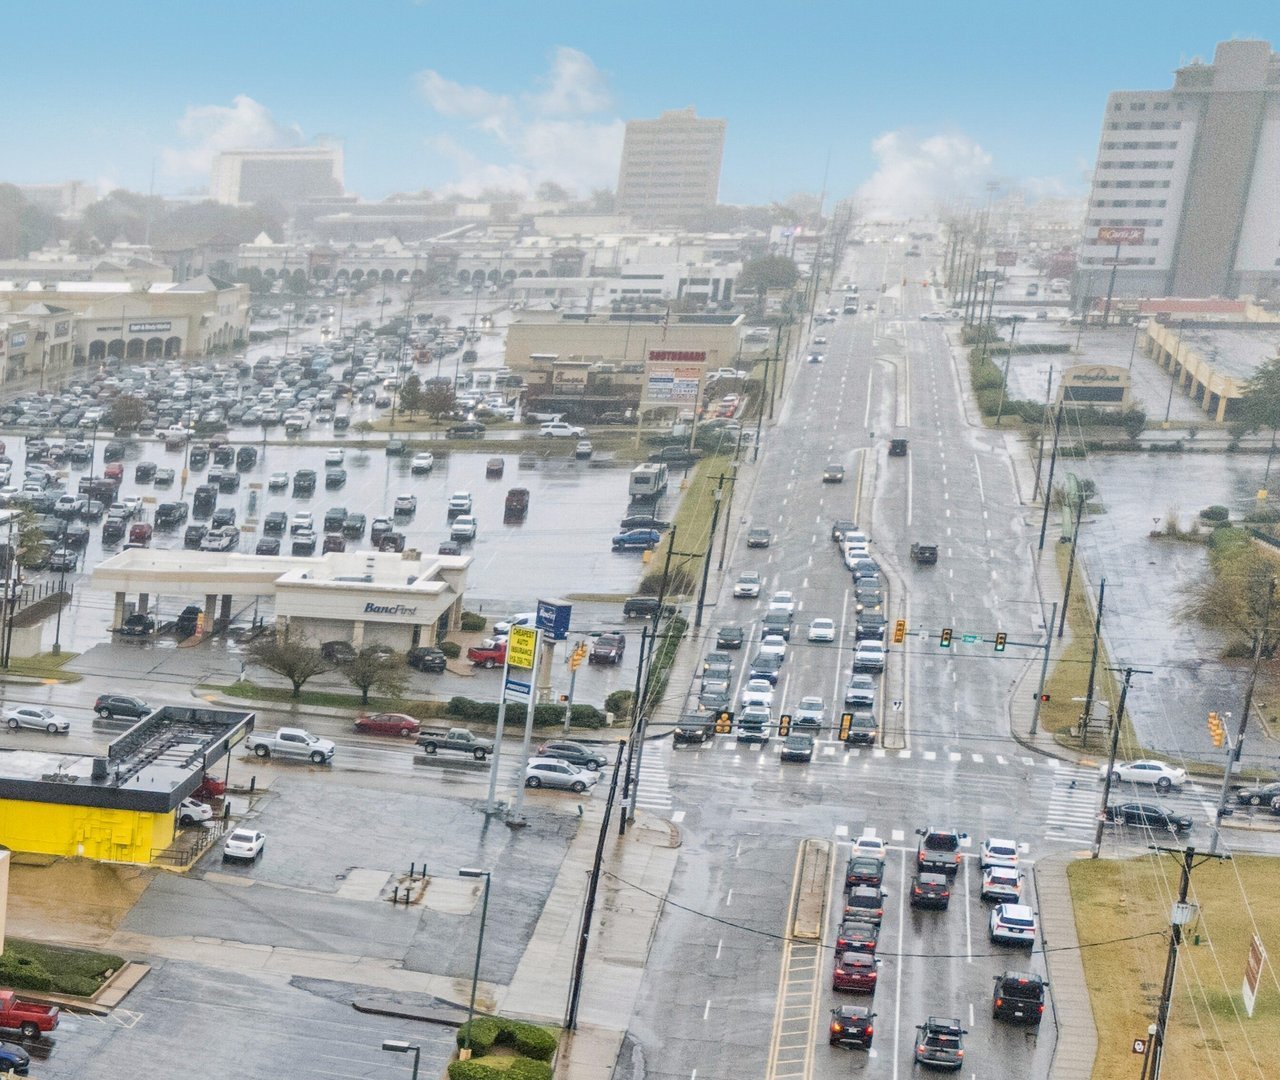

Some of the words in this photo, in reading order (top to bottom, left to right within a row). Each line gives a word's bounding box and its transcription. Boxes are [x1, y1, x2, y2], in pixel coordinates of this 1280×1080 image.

[364, 602, 417, 616] BancFirst
[513, 628, 535, 640] CHEAPEST
[517, 638, 529, 647] AUTO
[511, 646, 533, 657] INSURANCE
